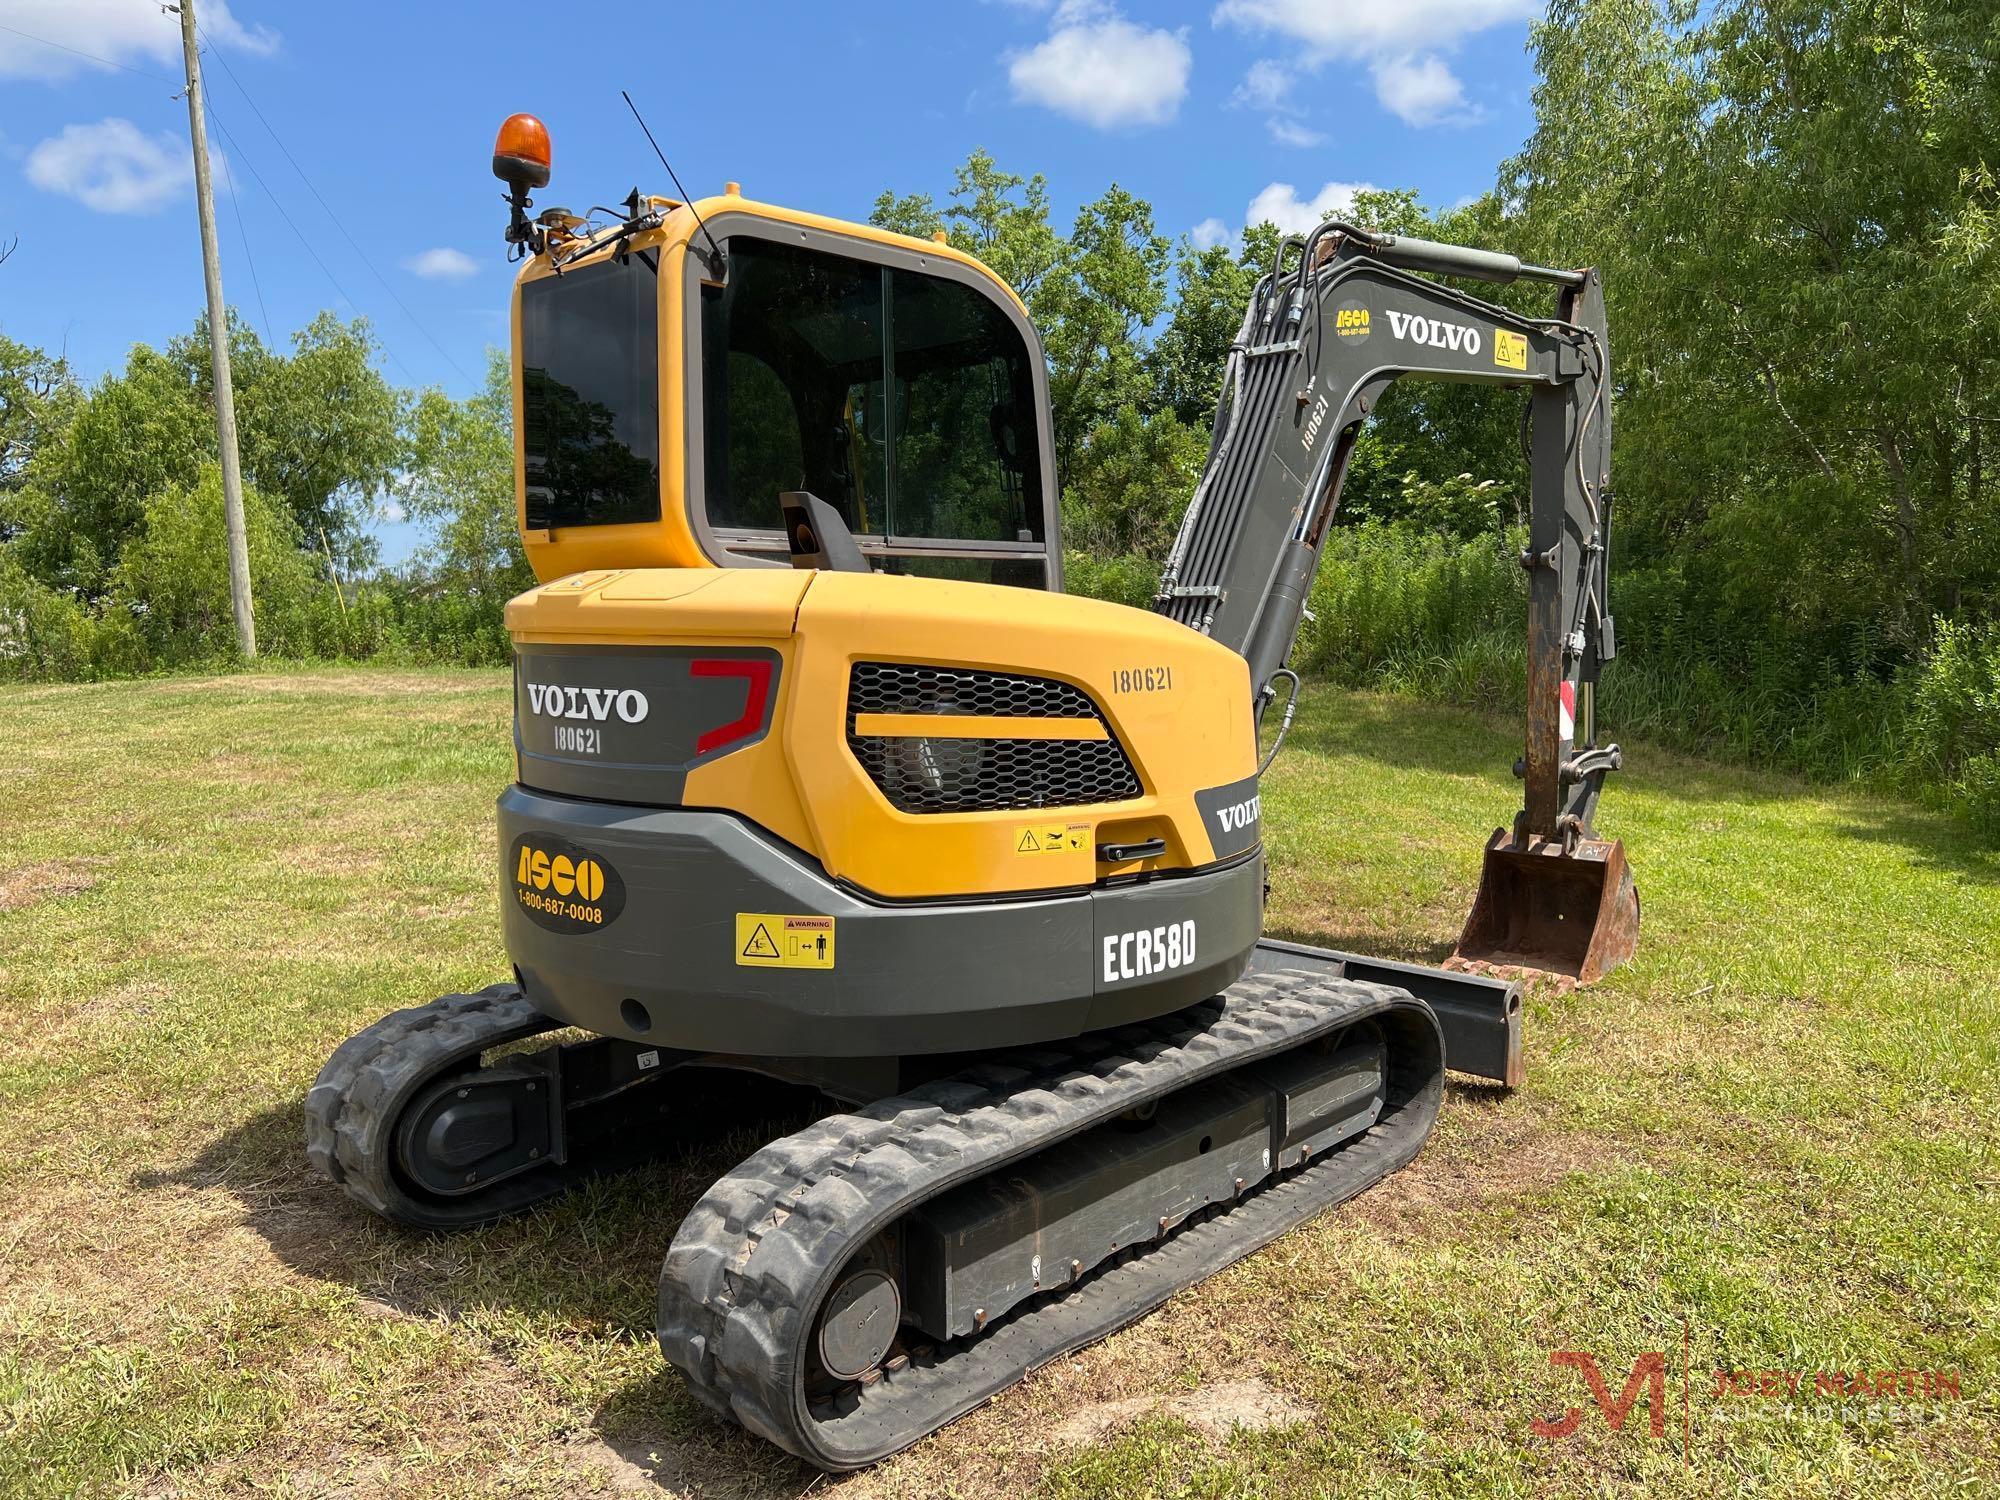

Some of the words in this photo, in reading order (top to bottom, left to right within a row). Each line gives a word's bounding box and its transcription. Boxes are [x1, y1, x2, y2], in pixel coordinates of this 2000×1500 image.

[1336, 309, 1370, 327] ASCO
[1385, 309, 1481, 355] VOLVO
[1301, 394, 1329, 451] 180621
[1112, 666, 1172, 694] 180621
[527, 683, 649, 723] VOLVO
[554, 725, 601, 754] 180621
[1216, 794, 1261, 833] VOLV
[517, 845, 605, 902] ASCO
[518, 888, 603, 924] 1-800-687-0008
[795, 920, 830, 928] WARNING
[1103, 919, 1196, 983] ECR58D
